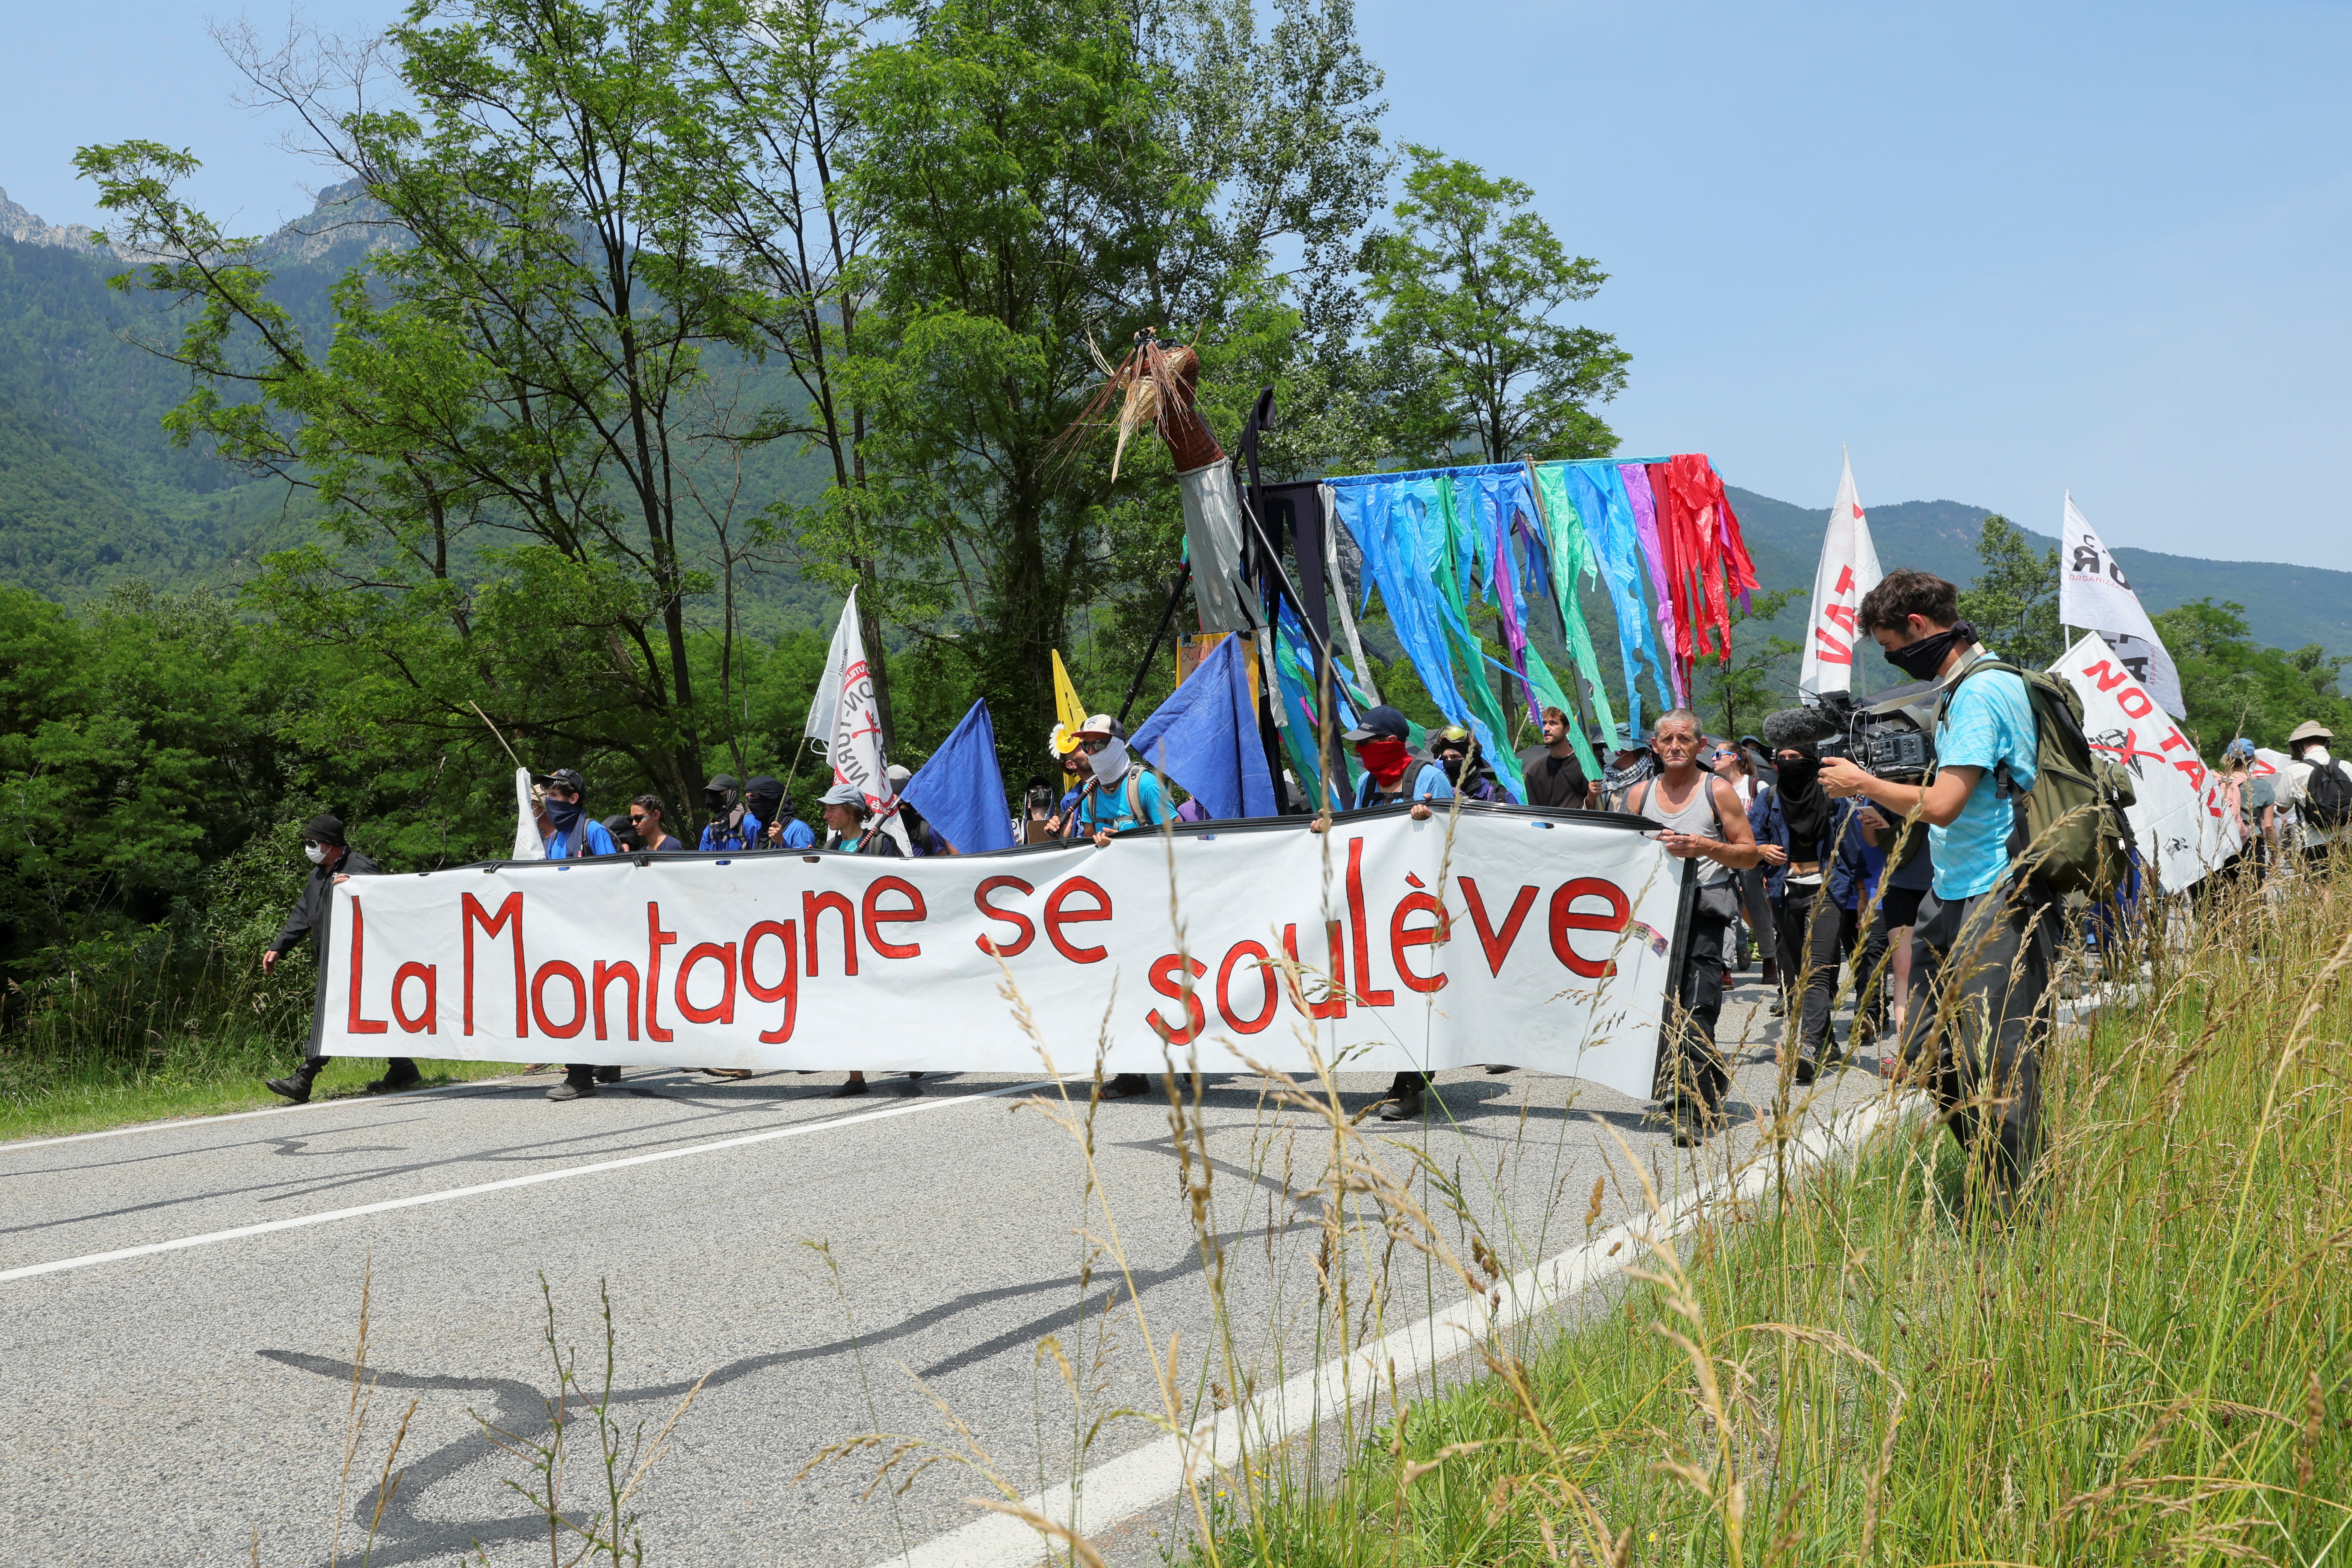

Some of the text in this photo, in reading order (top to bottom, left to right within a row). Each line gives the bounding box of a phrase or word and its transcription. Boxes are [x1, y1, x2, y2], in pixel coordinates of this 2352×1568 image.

[2082, 659, 2153, 719] NO
[347, 837, 1631, 1046] La Montagne se soulève
